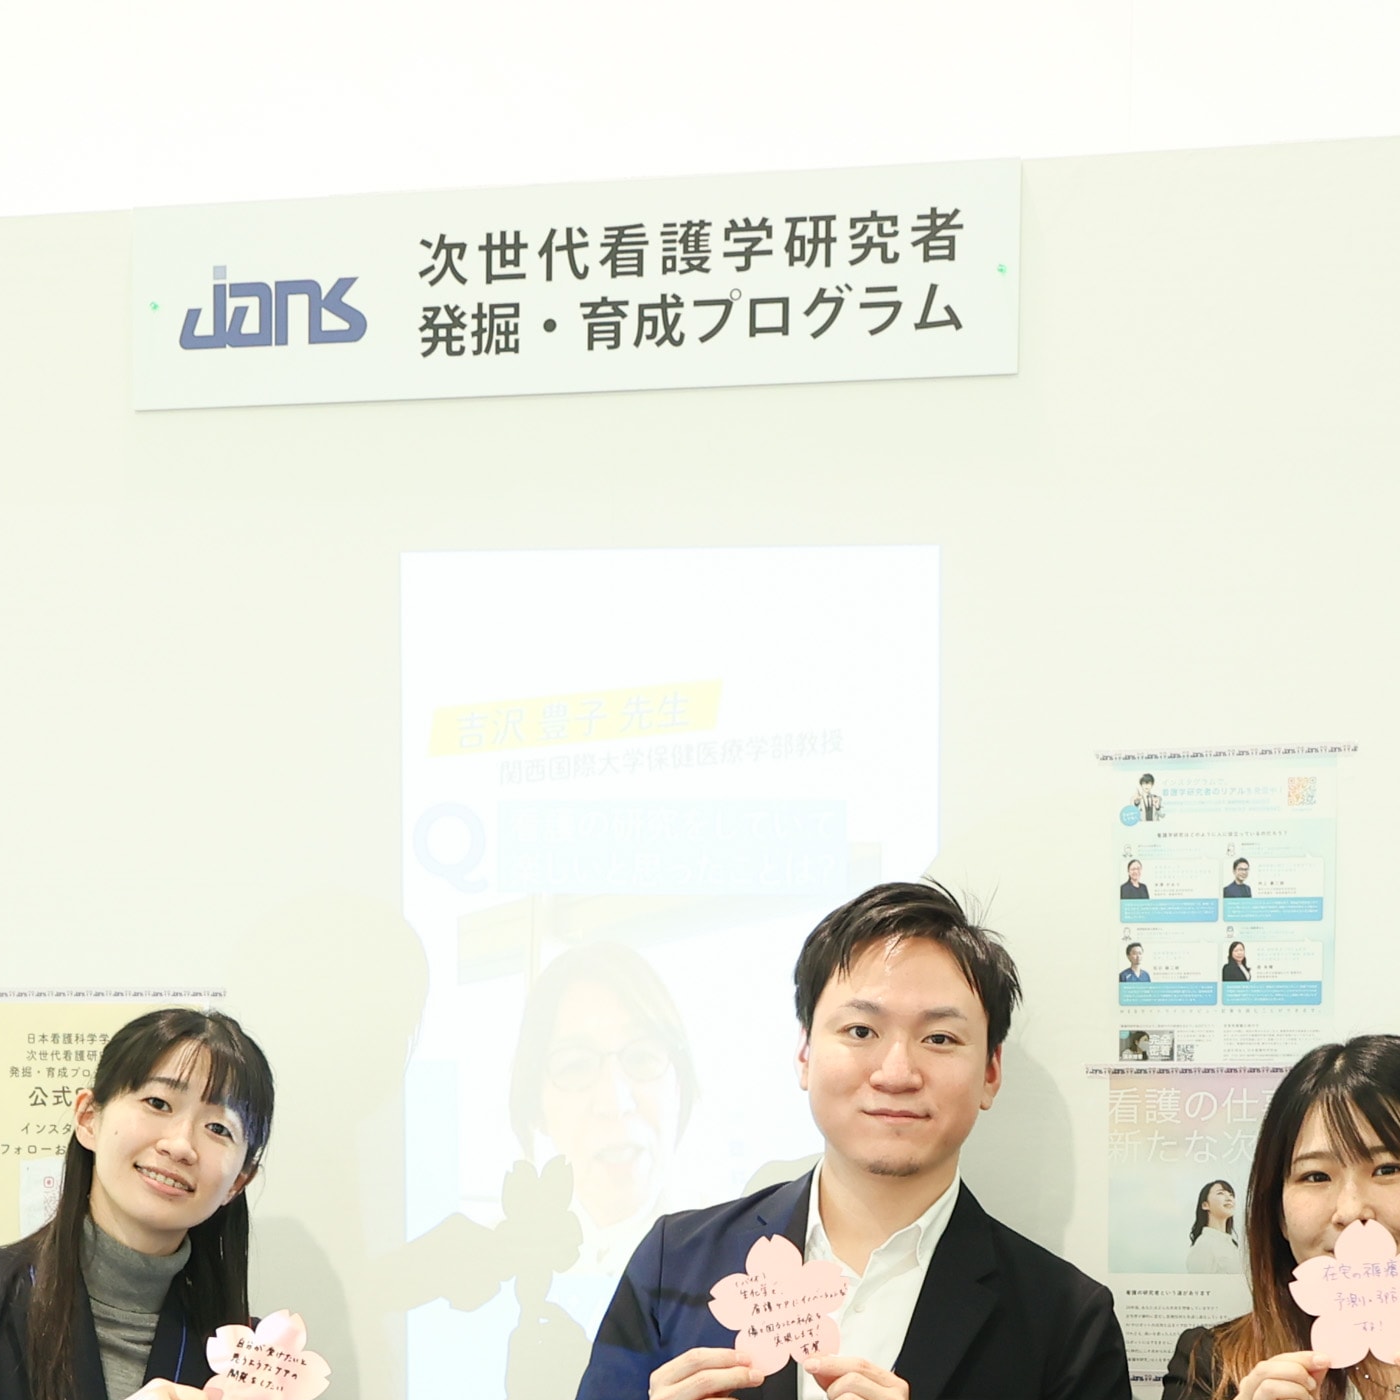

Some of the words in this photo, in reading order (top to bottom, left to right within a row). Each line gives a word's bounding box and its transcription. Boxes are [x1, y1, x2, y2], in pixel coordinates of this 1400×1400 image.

[418, 206, 966, 288] 次世代看護学研究者
[418, 282, 966, 359] 発掘・育成プログラム
[620, 690, 691, 735] 先生
[498, 727, 845, 786] 関西国際大学保健医療学部教授
[412, 802, 488, 895] Q
[9, 1066, 98, 1079] 発掘・育成プロ
[230, 1352, 298, 1380] 思うようなケアの
[236, 1337, 308, 1366] 自分が受けたいと
[226, 1368, 285, 1392] 開発をしたい
